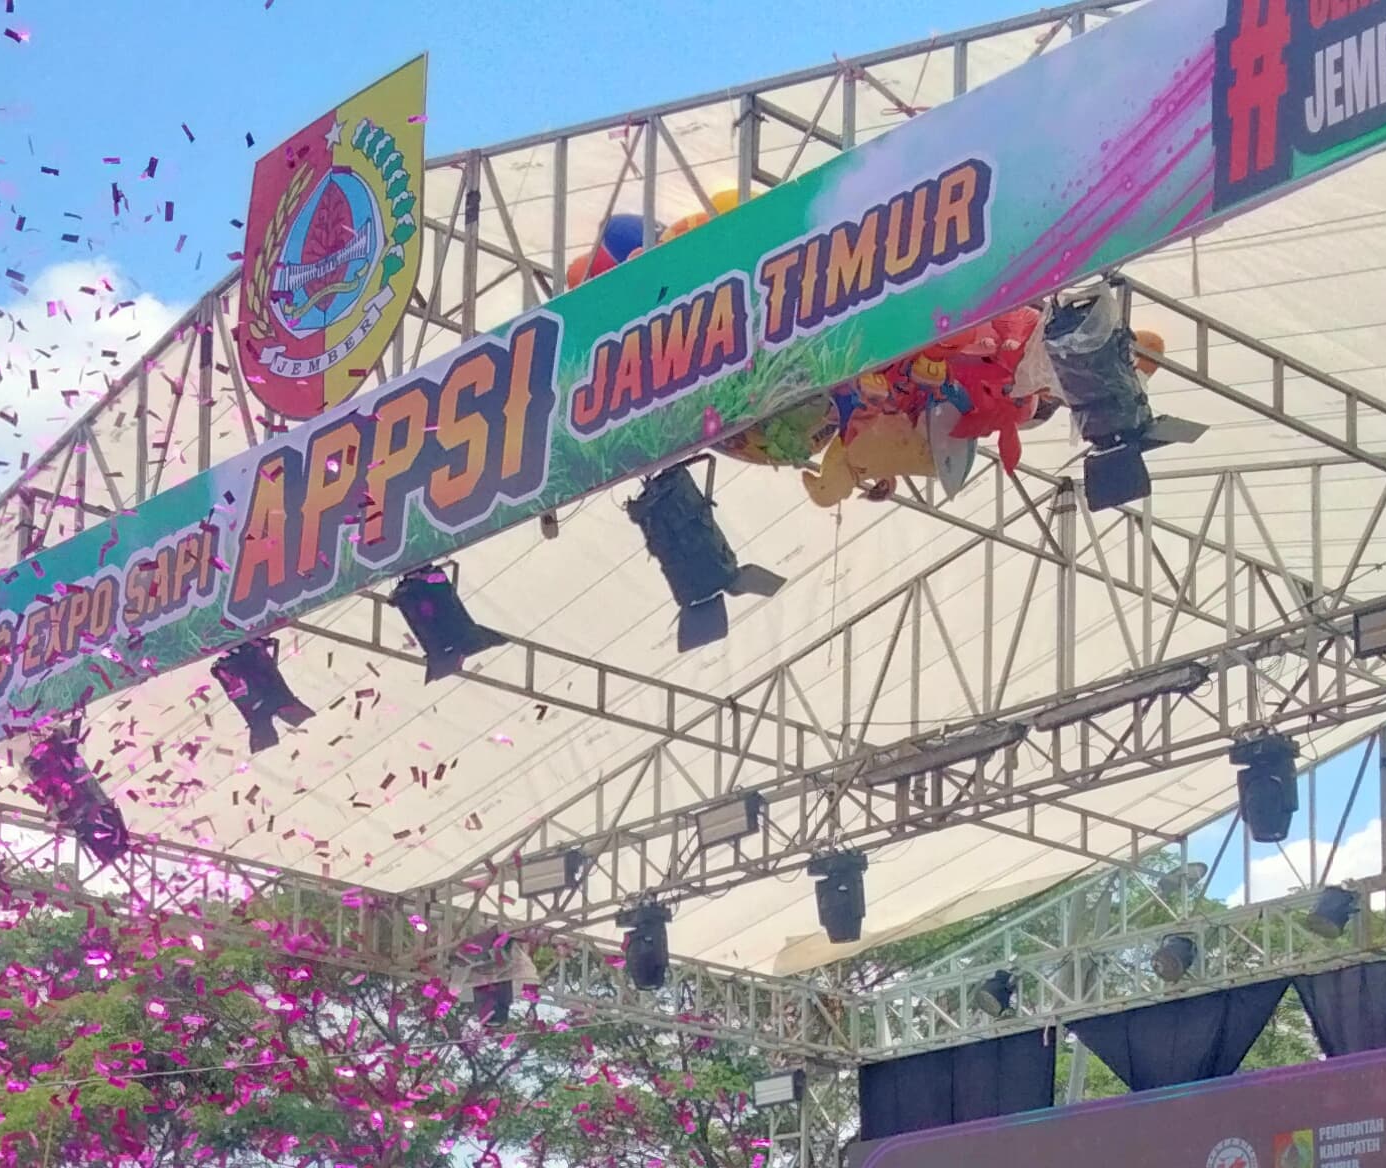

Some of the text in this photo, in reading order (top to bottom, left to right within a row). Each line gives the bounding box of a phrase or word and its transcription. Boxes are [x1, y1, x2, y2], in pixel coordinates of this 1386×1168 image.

[277, 317, 373, 377] JEMBER
[21, 578, 119, 679] EXPO
[124, 526, 219, 628] SAPI
[227, 320, 555, 618] APPSI
[570, 284, 749, 432] JAWA
[761, 160, 991, 343] TIMUR
[1319, 1117, 1385, 1142] PEMERINTAH
[1319, 1137, 1381, 1160] KABUPATEN
